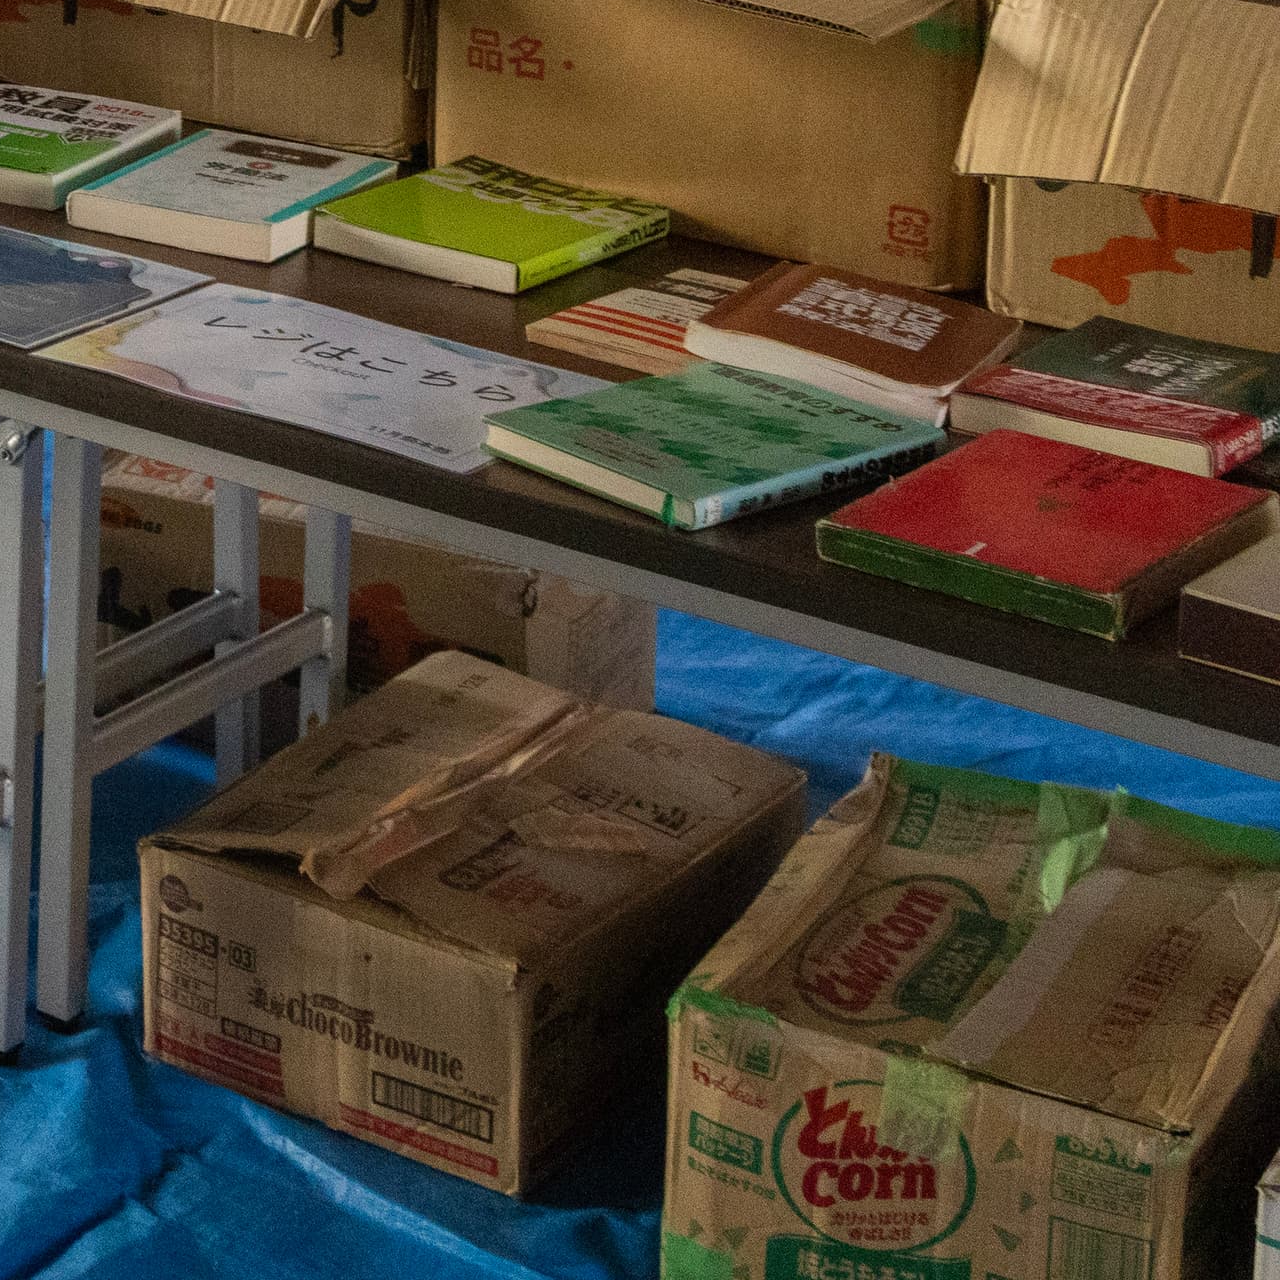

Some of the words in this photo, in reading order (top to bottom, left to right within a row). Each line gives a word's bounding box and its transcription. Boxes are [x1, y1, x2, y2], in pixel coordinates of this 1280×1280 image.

[203, 316, 516, 403] レジはこちら
[291, 356, 372, 380] Checkout
[161, 918, 217, 954] 35395
[286, 991, 465, 1081] ChocoBrownie
